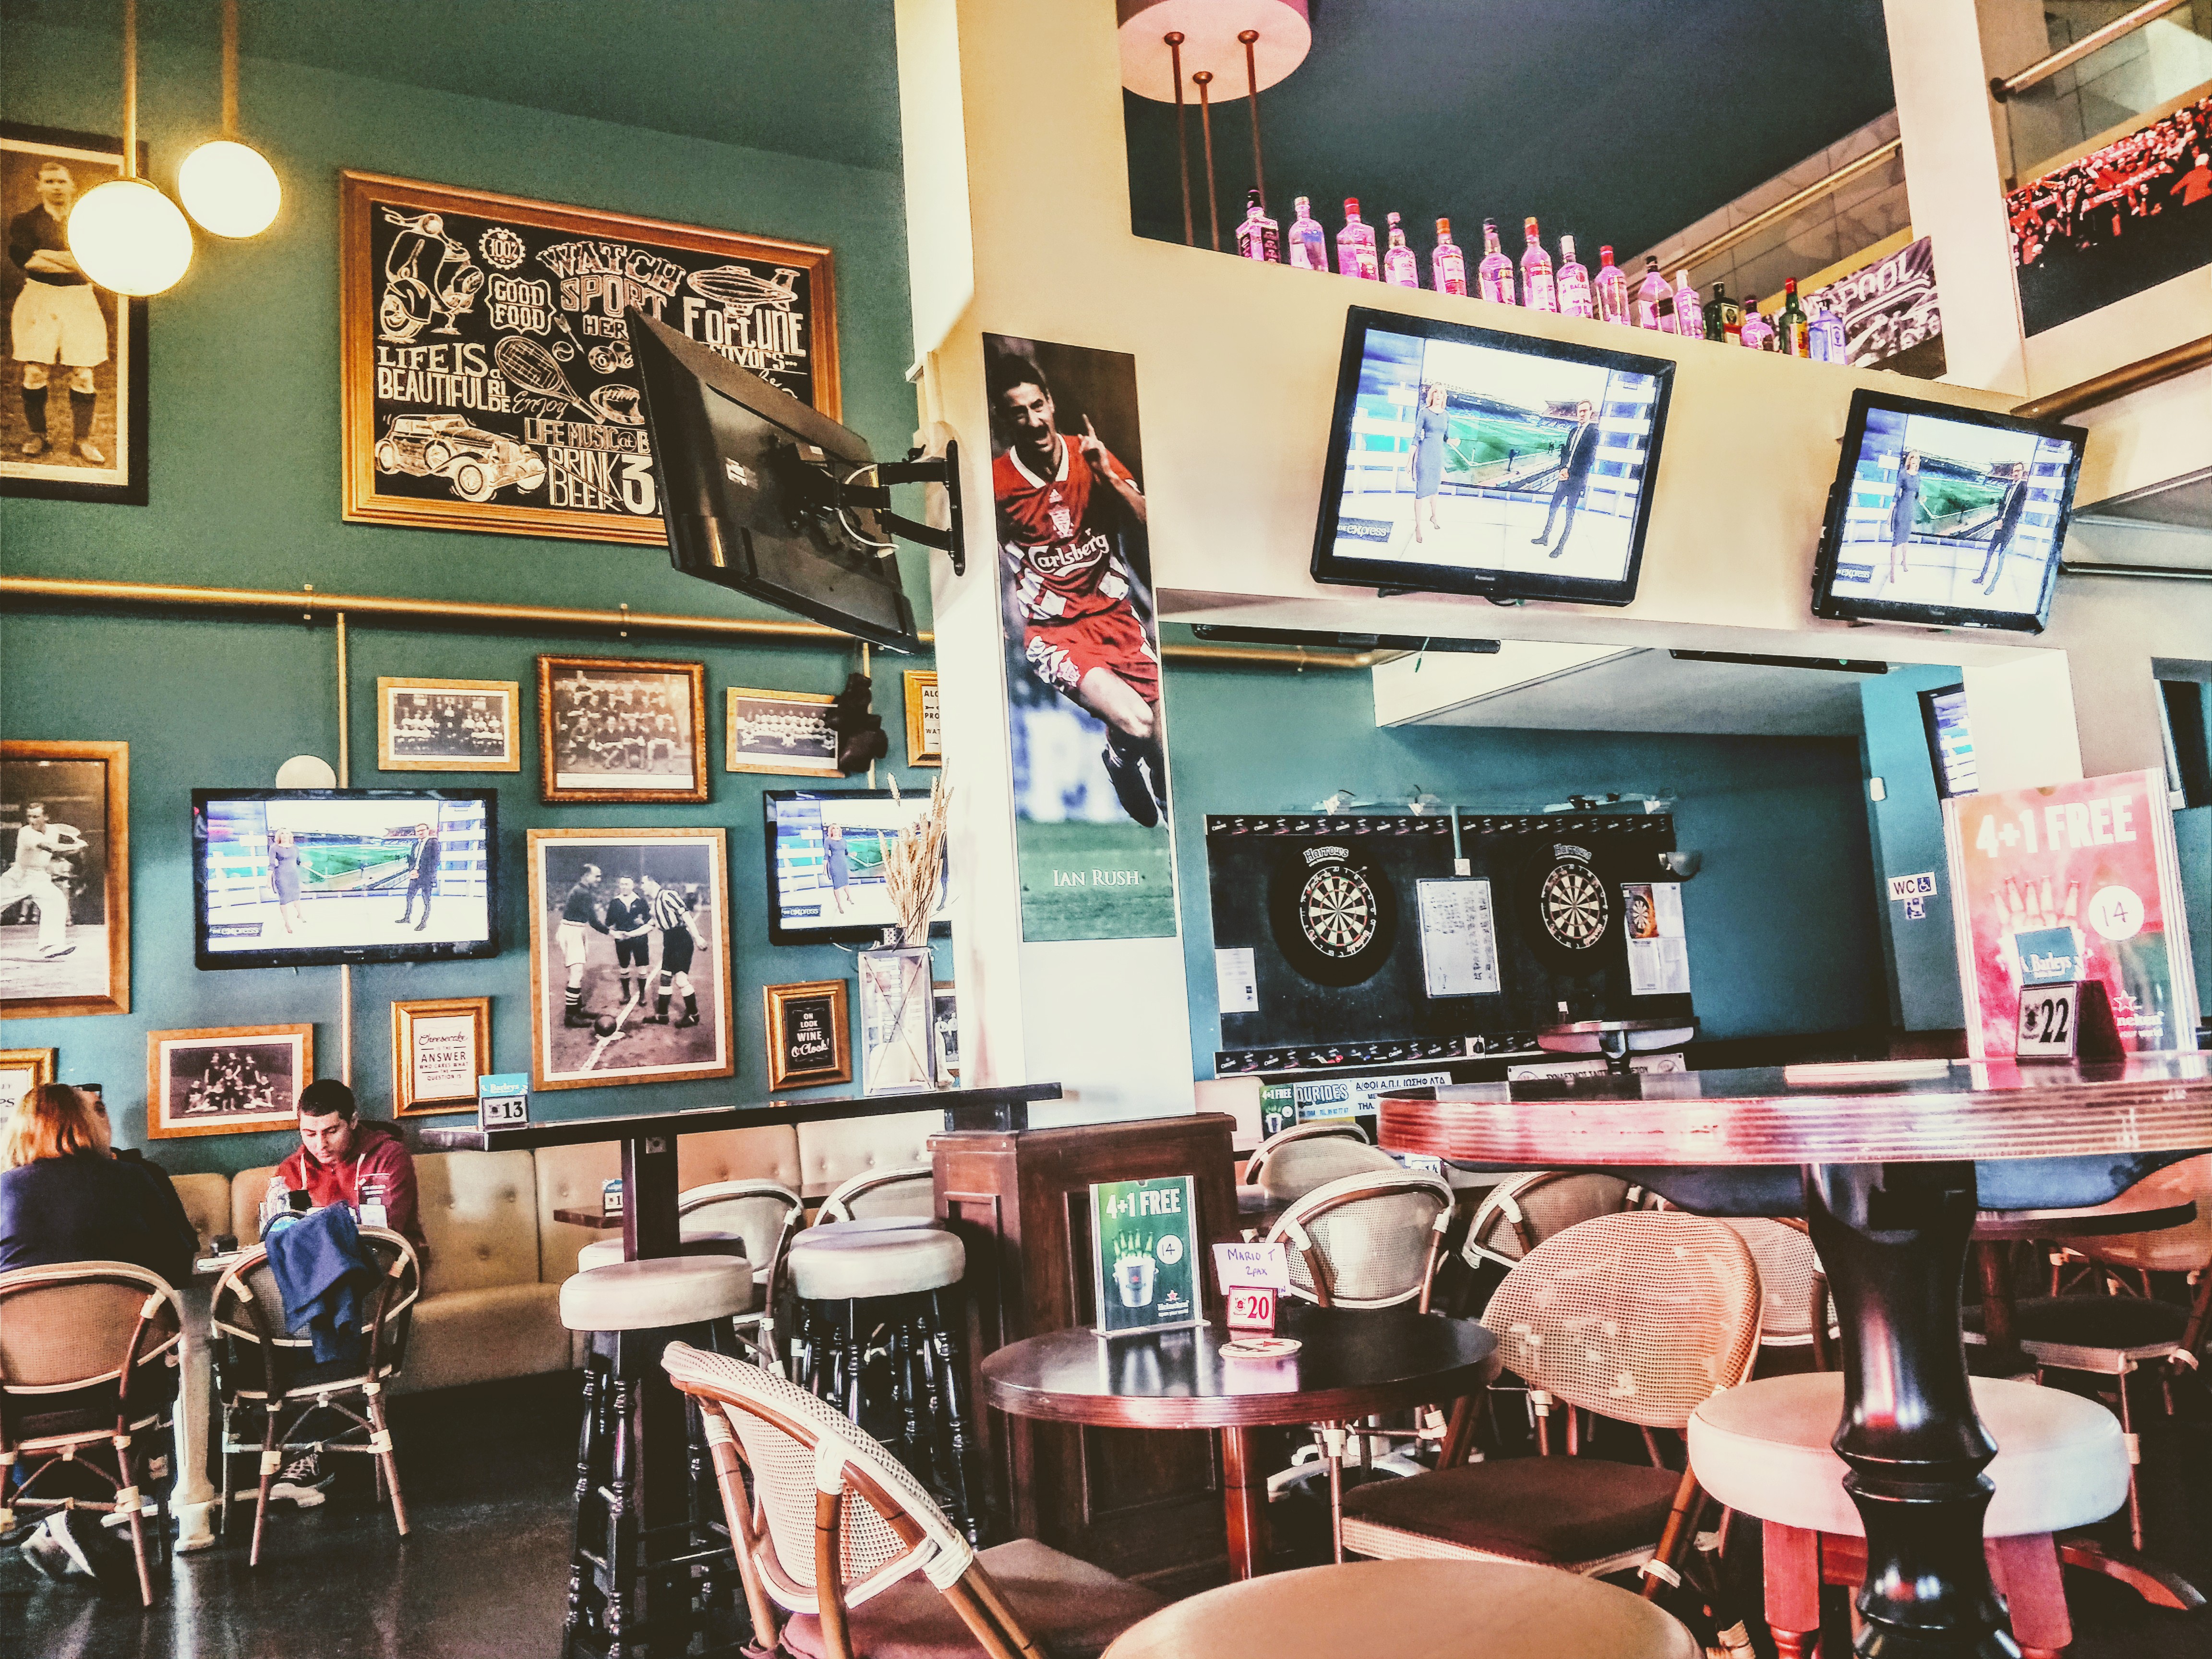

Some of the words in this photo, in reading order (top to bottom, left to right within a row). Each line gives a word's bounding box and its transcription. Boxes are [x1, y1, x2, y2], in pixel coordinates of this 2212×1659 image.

[535, 241, 686, 297] WATCH
[494, 280, 545, 307] GOOD
[561, 275, 667, 321] SPORT
[495, 303, 545, 329] FOOD
[377, 344, 449, 373] LIFE
[453, 343, 489, 378] IS
[377, 367, 488, 410] BEAUTIFUL
[525, 417, 565, 446] LIFE
[567, 421, 620, 452] MUSIC
[547, 446, 624, 501] DRINK
[548, 459, 622, 512] BEER
[1028, 534, 1110, 574] Carlsberg
[1976, 808, 2038, 858] 4+1
[2044, 794, 2138, 851] FREE
[1893, 879, 1915, 895] WC
[2102, 901, 2129, 927] 14
[800, 1020, 818, 1028] LOOK
[2039, 997, 2069, 1043] 22
[796, 1031, 822, 1042] WINE
[421, 1051, 466, 1063] ANSWER
[502, 1101, 523, 1118] 13
[1106, 1192, 1136, 1220] 4+1
[1139, 1187, 1182, 1216] FREE
[1162, 1243, 1176, 1256] 14
[1227, 1248, 1261, 1261] MARIO
[1247, 1296, 1269, 1320] 20
